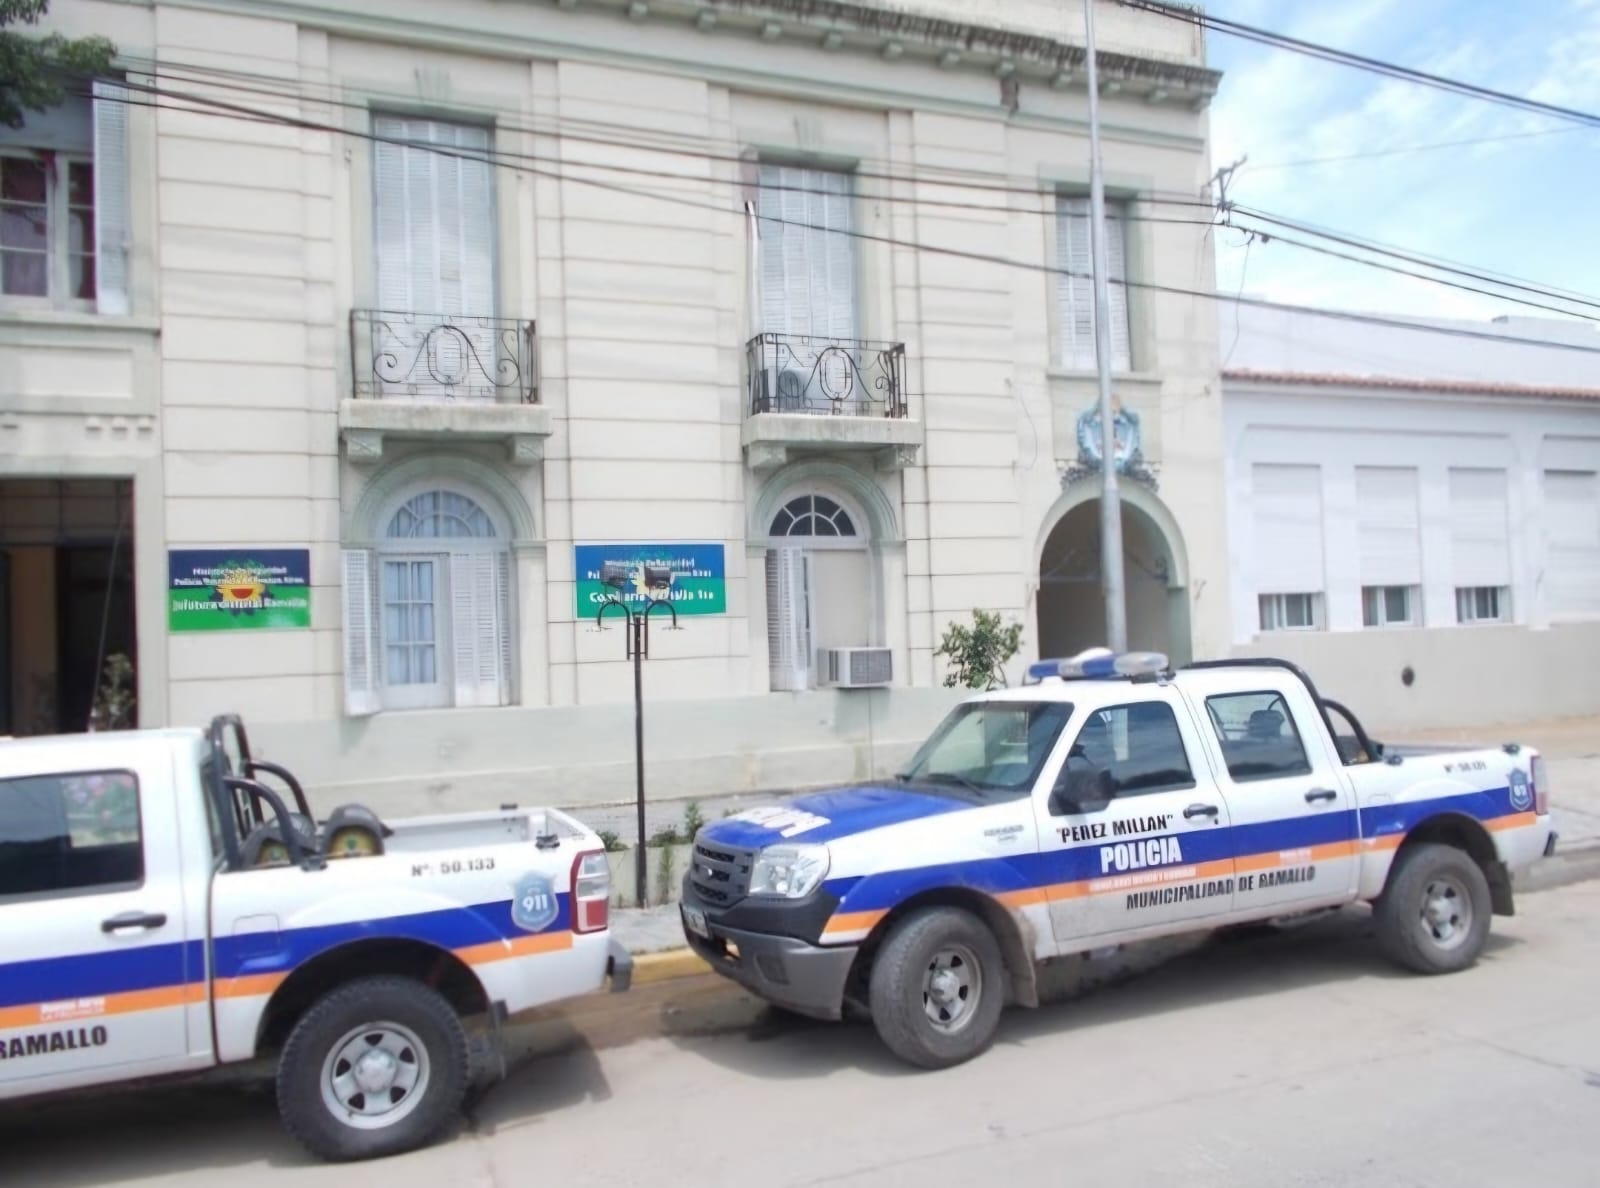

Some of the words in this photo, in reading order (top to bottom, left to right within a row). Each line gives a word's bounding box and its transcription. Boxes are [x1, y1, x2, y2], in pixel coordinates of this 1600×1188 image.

[440, 857, 495, 874] 50.133
[1100, 836, 1183, 873] POLICIA
[522, 895, 548, 912] 911
[1126, 878, 1234, 910] MUNICIPALIDAD
[1238, 875, 1254, 892] DE
